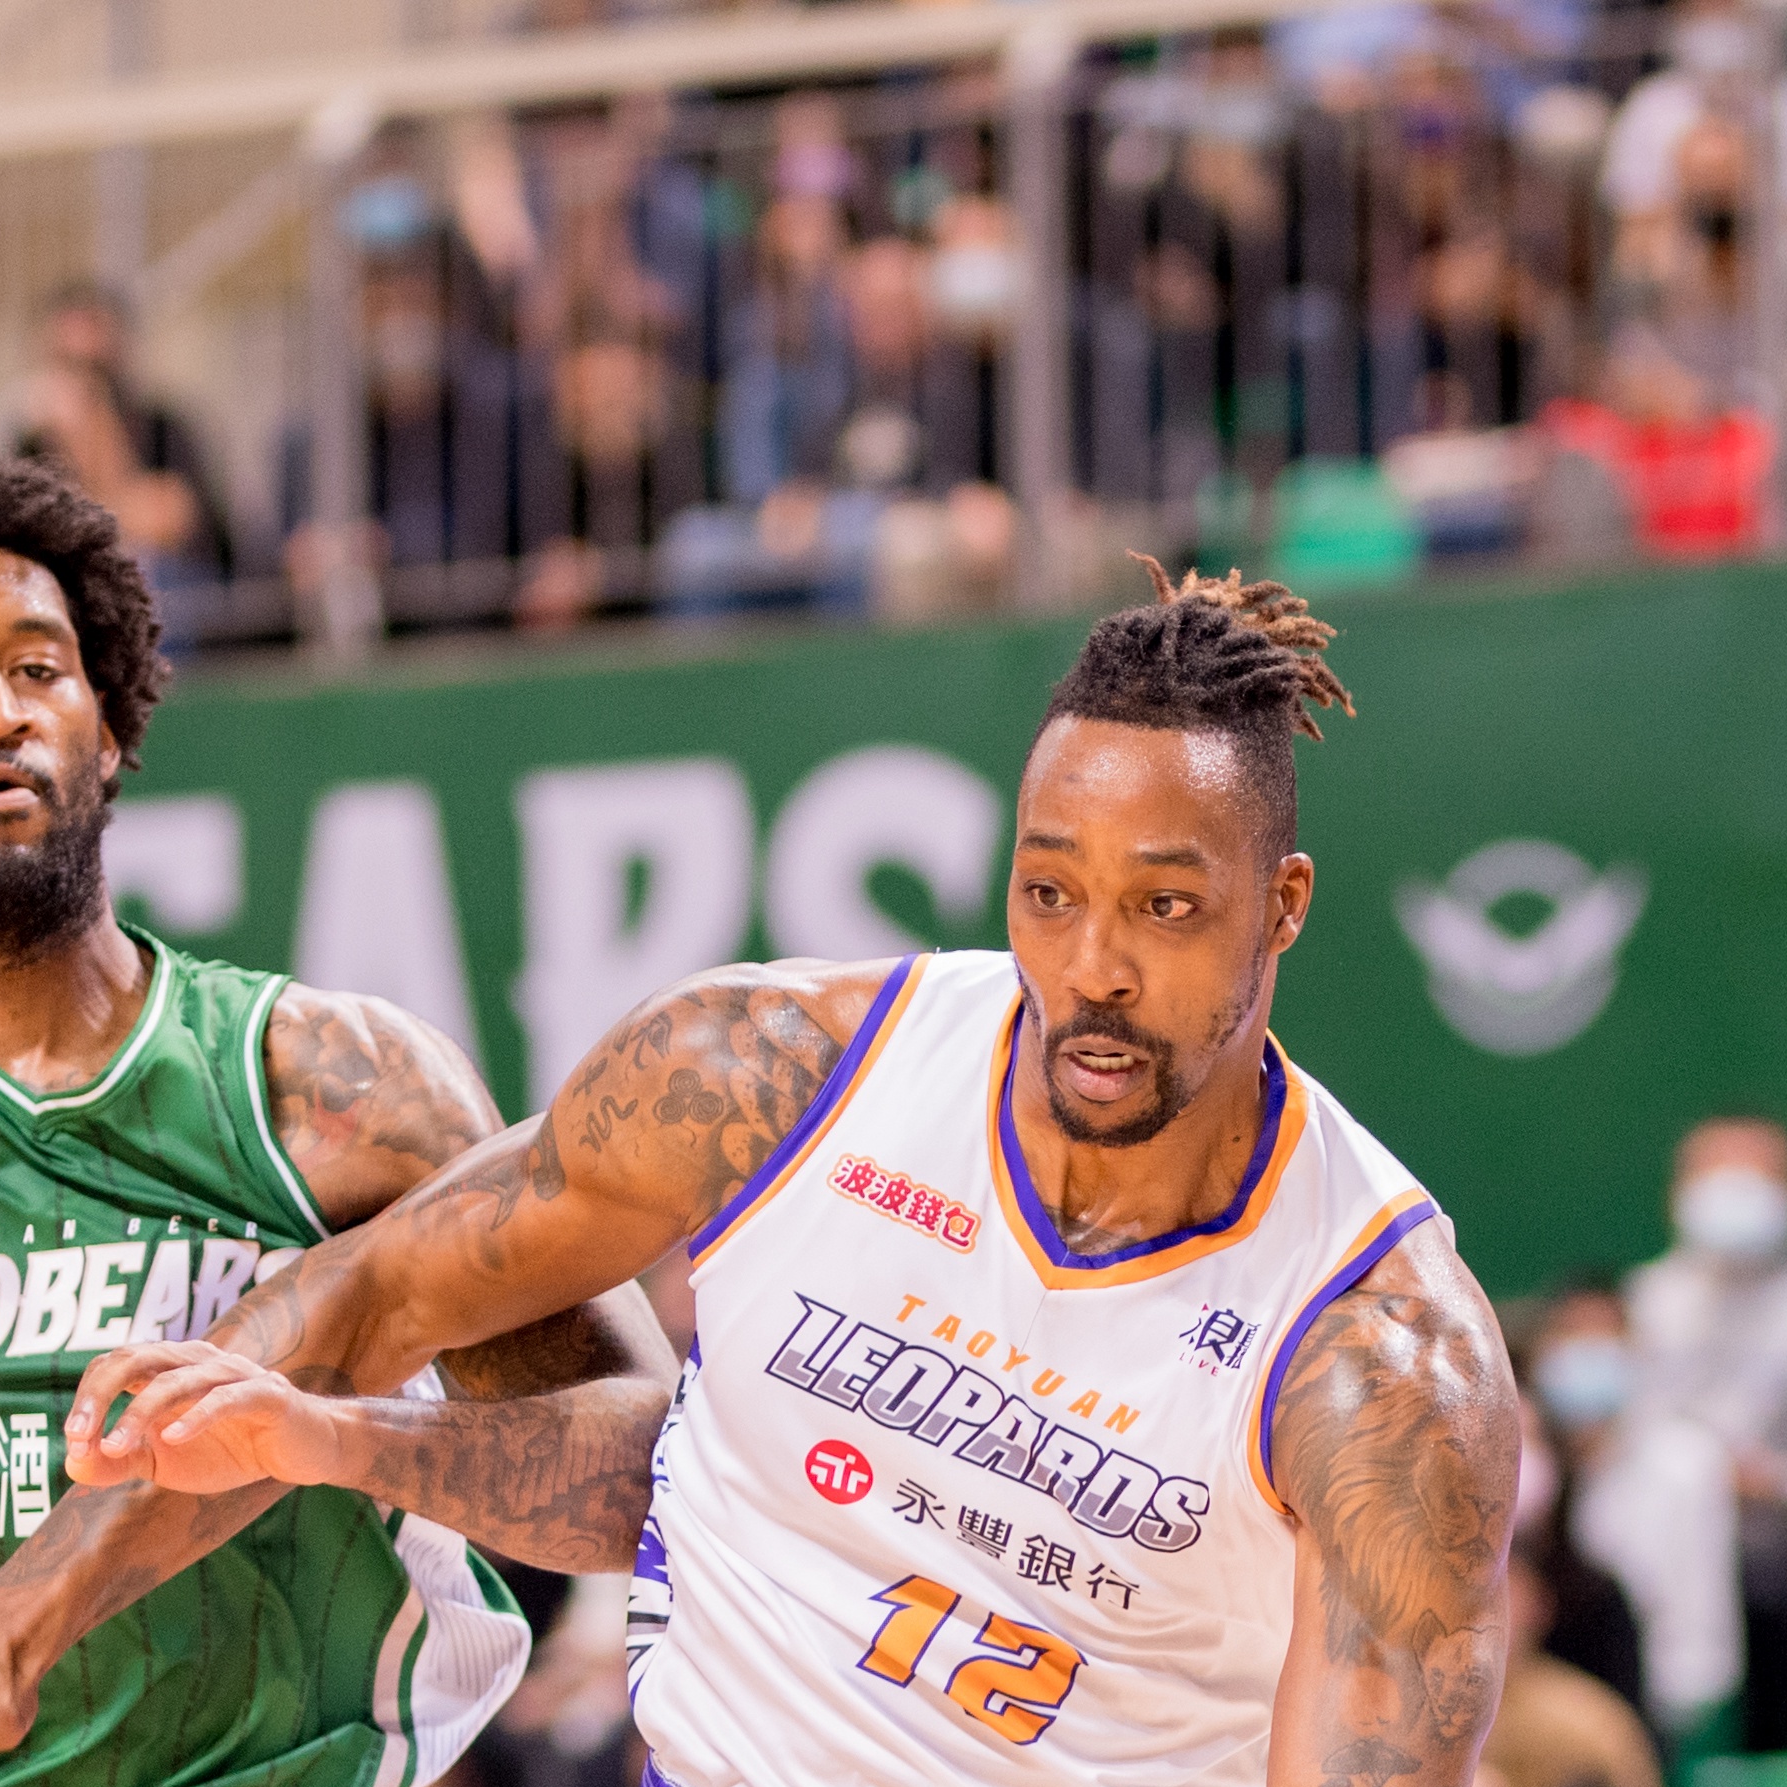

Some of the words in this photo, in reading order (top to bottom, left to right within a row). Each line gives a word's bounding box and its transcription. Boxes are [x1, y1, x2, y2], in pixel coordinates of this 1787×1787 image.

[126, 1214, 259, 1240] BEER
[831, 1153, 978, 1250] 波波錢包
[764, 1290, 1211, 1554] LEOPARDS
[894, 1293, 1142, 1435] TAOYUAN
[1178, 1351, 1221, 1377] LIVE
[891, 1477, 1142, 1611] 永豐銀行
[856, 1574, 1089, 1746] 12
